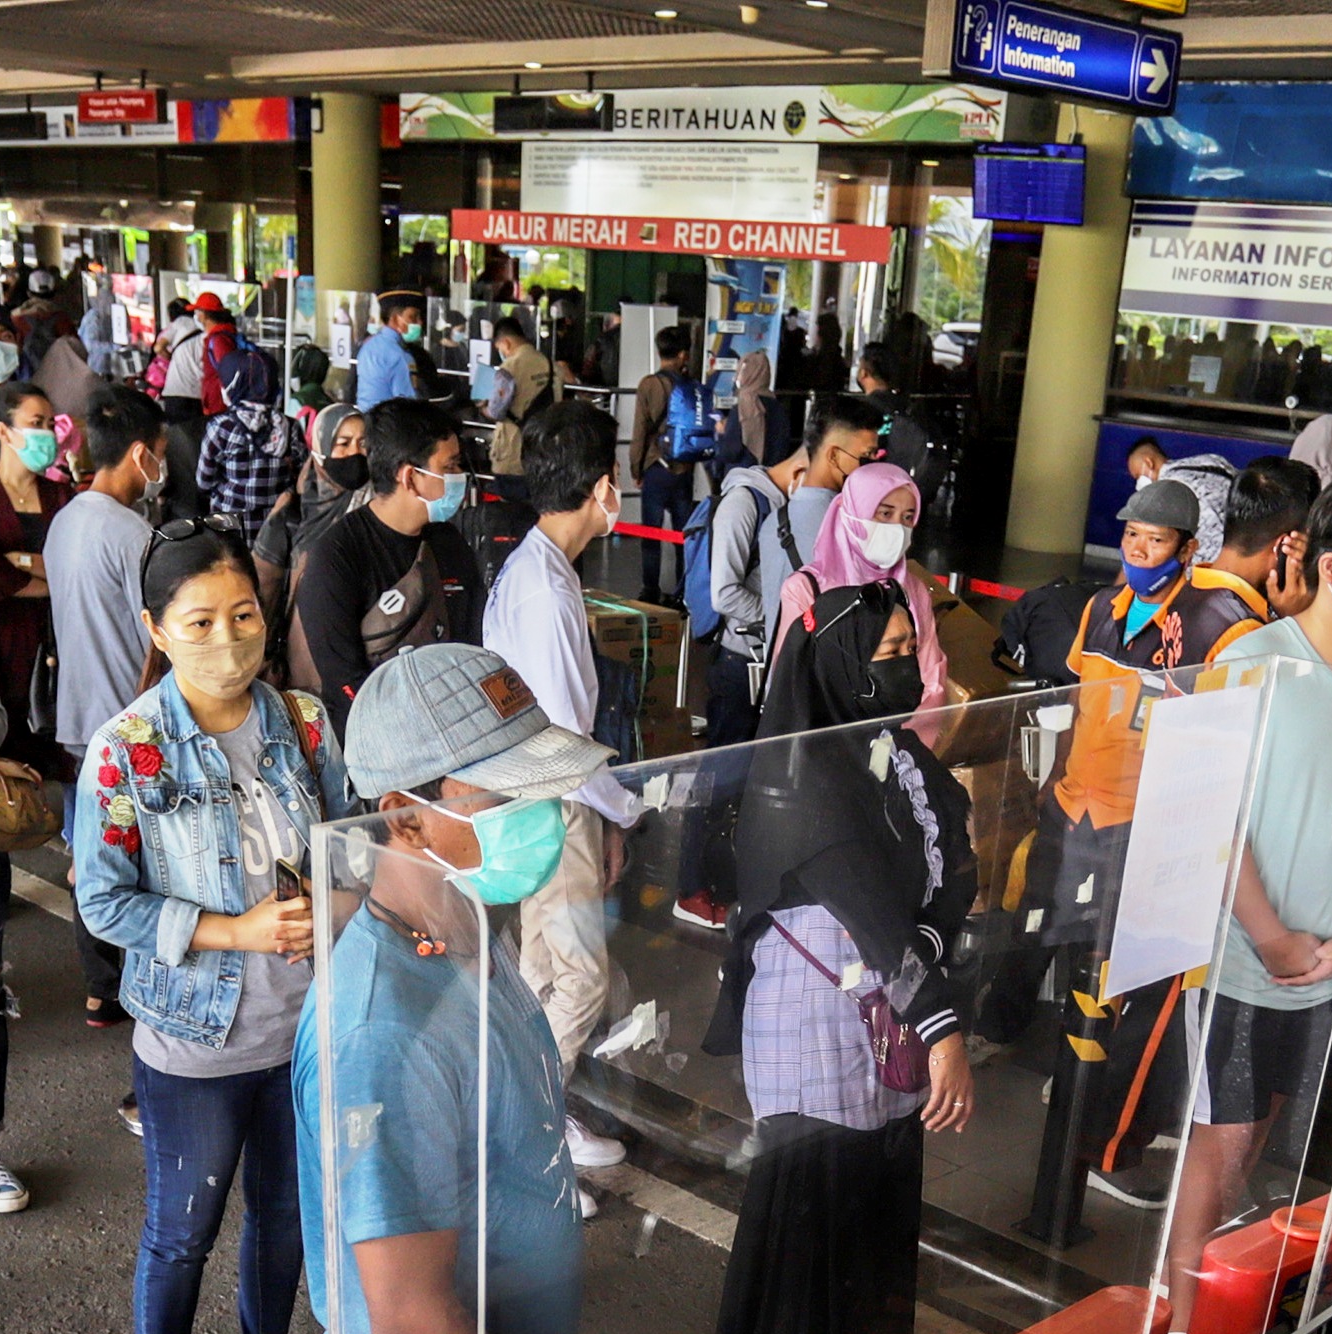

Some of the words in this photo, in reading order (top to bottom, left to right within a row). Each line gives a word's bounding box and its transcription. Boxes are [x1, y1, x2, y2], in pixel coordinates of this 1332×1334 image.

[1007, 14, 1081, 52] Penerangan
[1004, 43, 1075, 78] Information
[613, 107, 776, 130] BERITAHUAN
[483, 213, 547, 241] JALUR
[552, 216, 628, 245] MERAH
[673, 221, 721, 250] RED
[728, 224, 846, 256] CHANNEL
[1149, 237, 1266, 264] LAYANAN
[1172, 266, 1292, 288] INFORMATION
